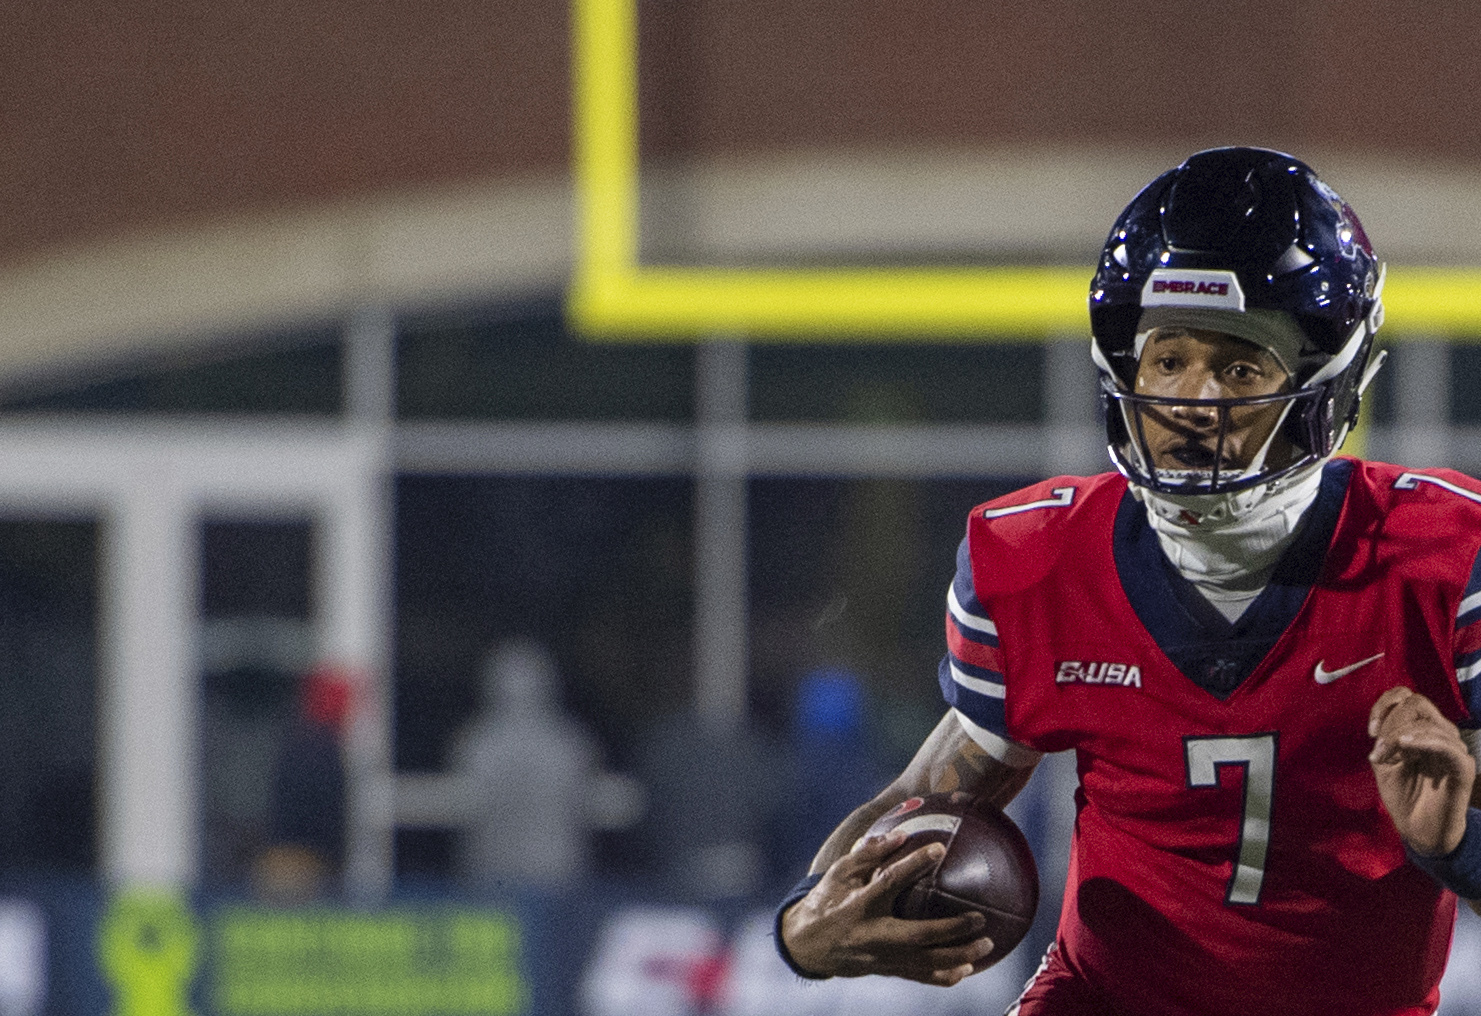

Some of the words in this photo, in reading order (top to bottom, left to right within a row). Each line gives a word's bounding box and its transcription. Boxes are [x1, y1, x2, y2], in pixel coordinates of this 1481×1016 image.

[1152, 280, 1229, 296] EMBRACE
[982, 486, 1076, 519] 7
[1182, 731, 1280, 908] 7
